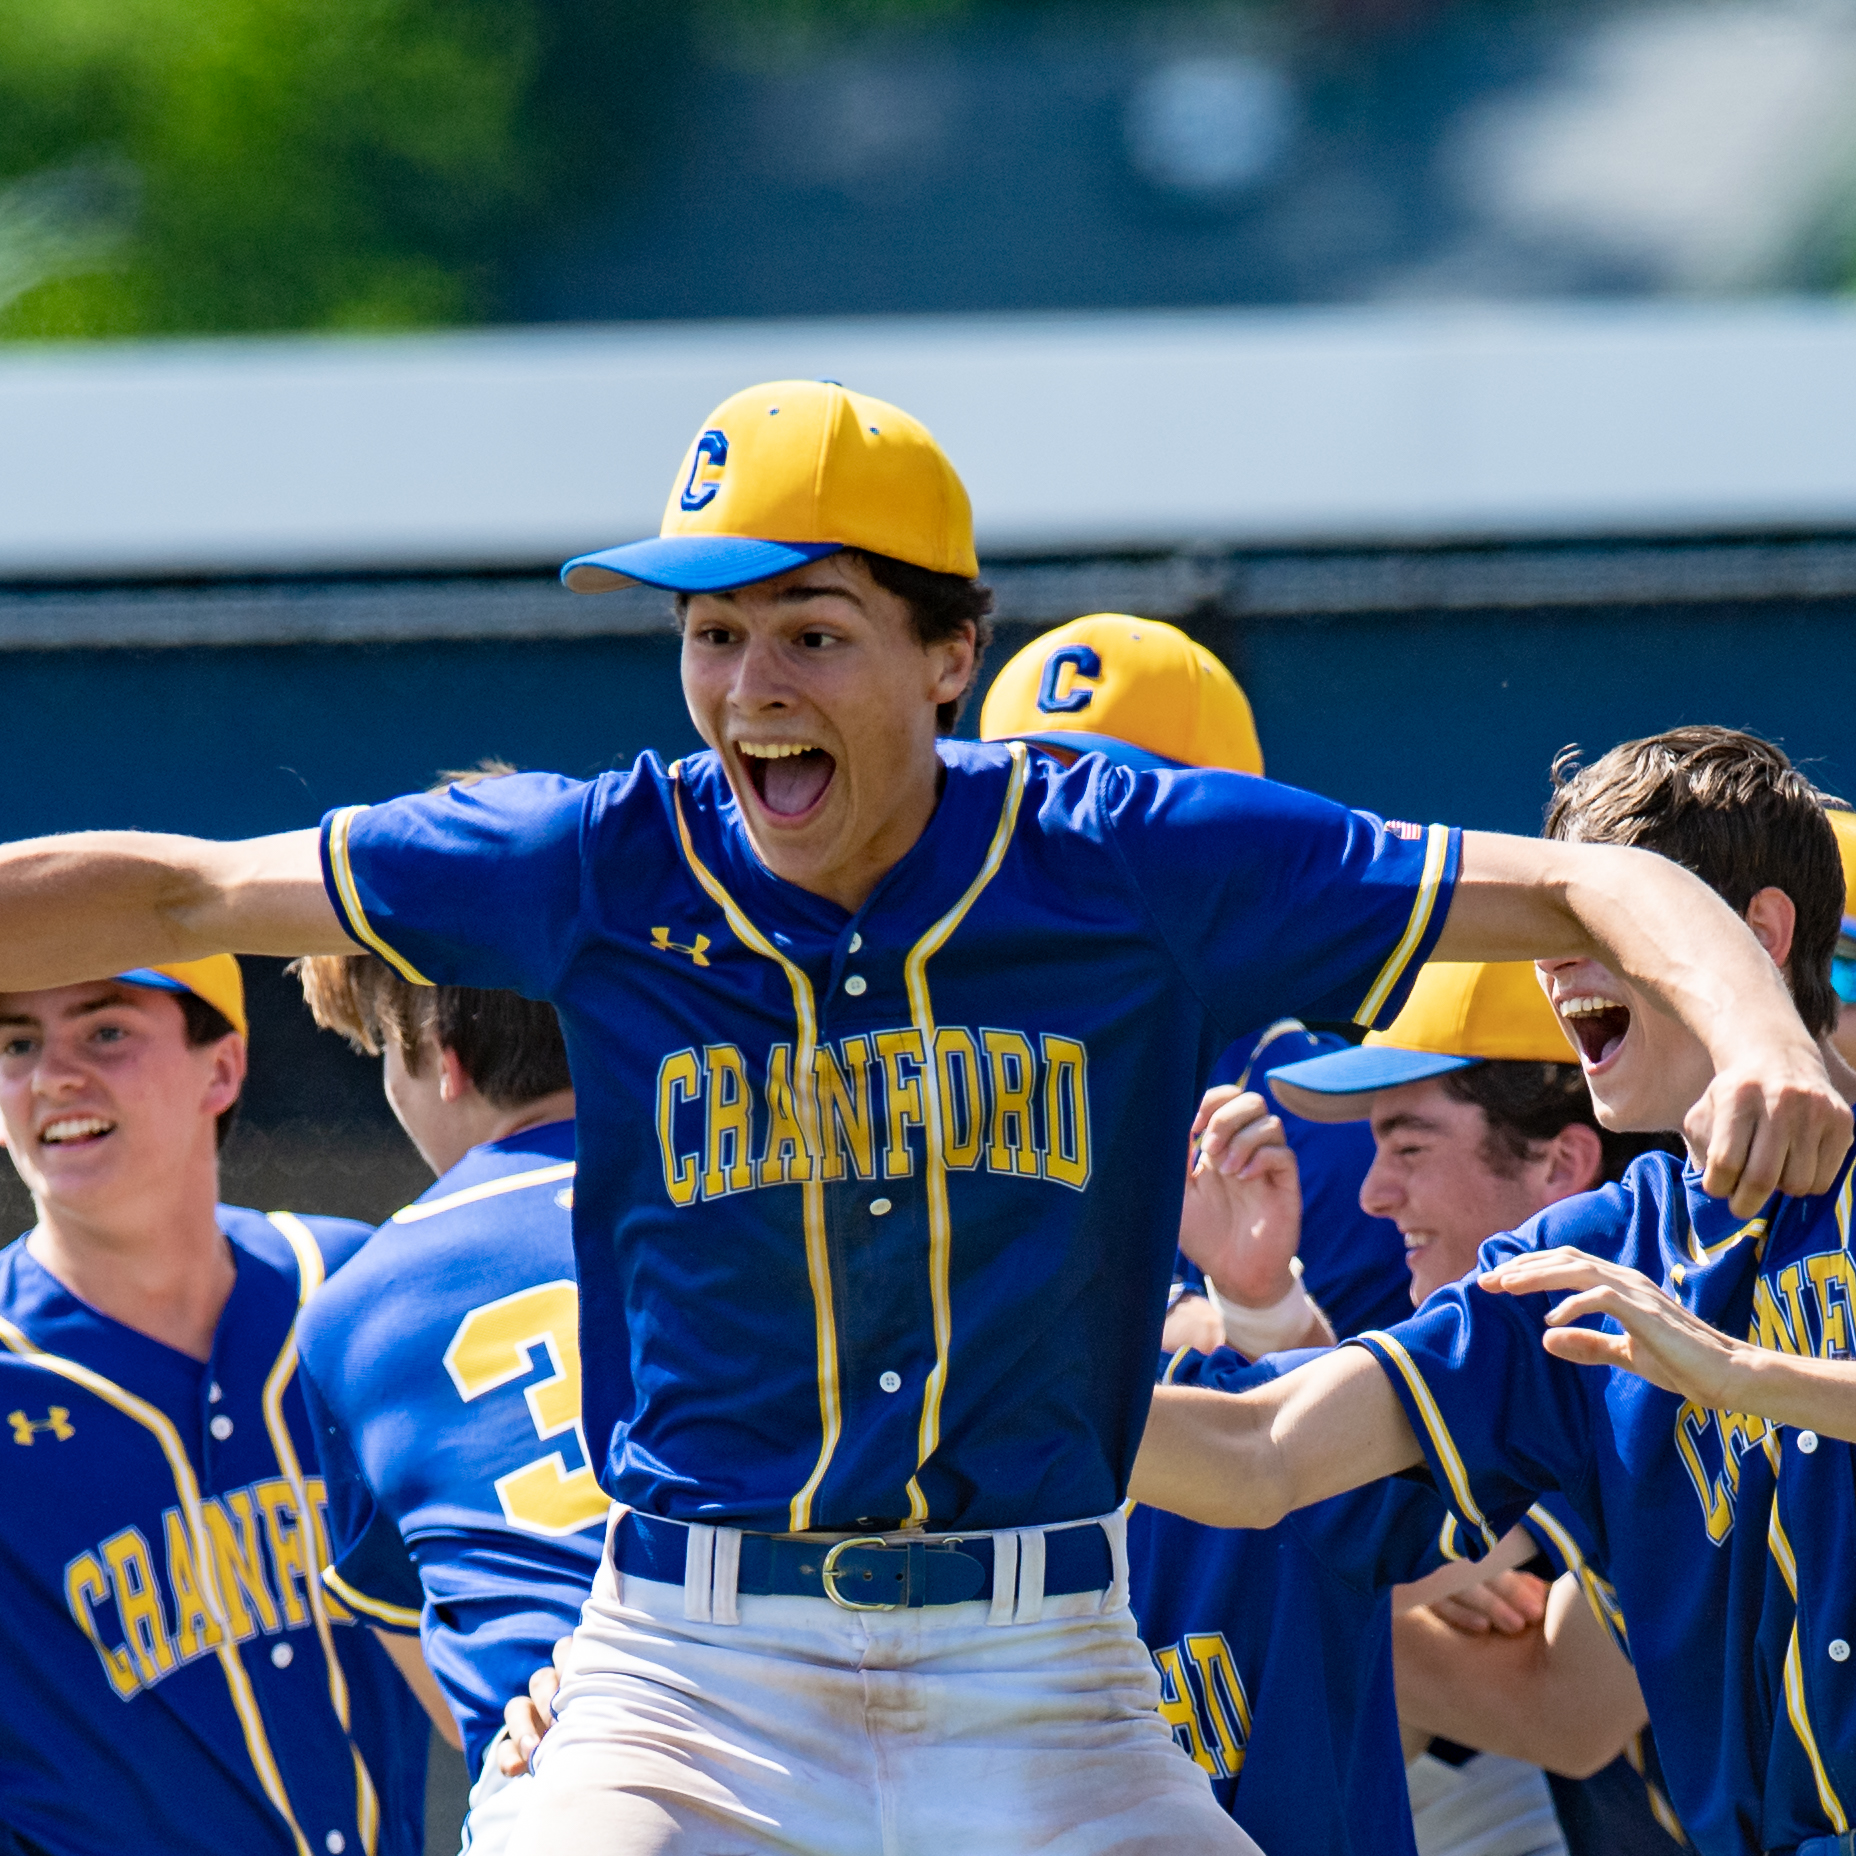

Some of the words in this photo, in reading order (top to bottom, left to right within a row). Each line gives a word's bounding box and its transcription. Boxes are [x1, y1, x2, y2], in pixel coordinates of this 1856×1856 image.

[680, 429, 729, 511] C
[1037, 645, 1102, 713] C
[655, 1026, 1092, 1207] CRANFORD
